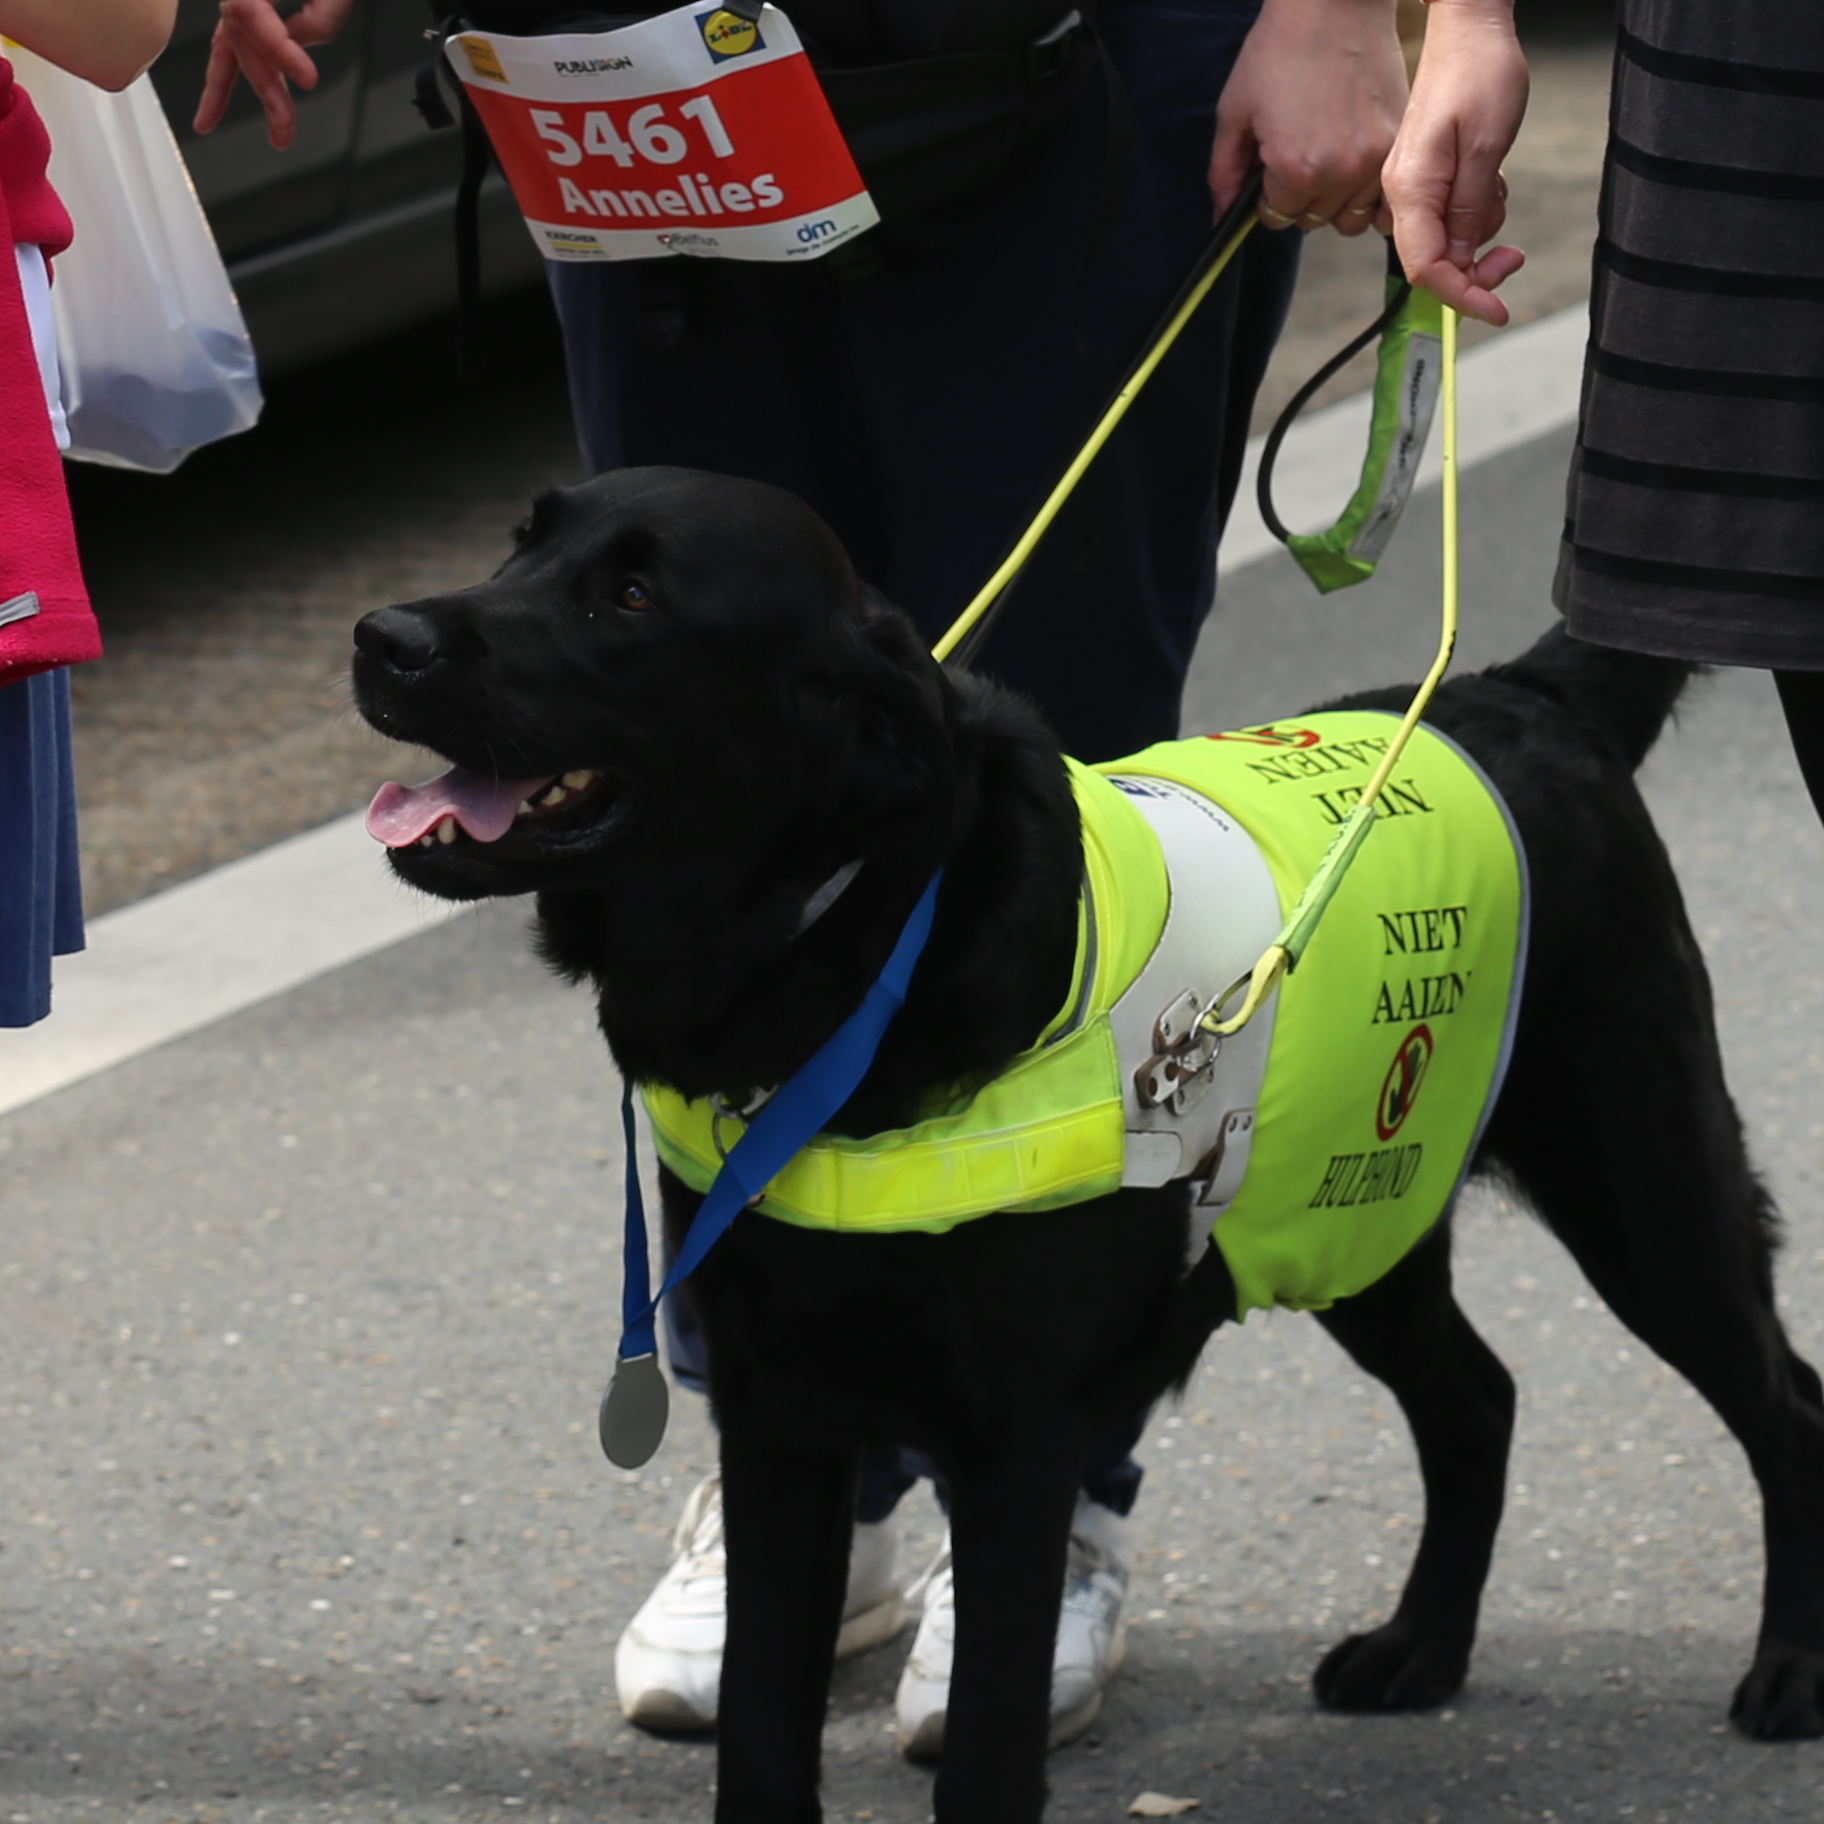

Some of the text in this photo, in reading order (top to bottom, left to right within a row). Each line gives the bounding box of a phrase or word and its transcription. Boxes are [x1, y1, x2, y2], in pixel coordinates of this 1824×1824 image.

[529, 94, 735, 168] 5461
[557, 172, 784, 218] Annelies
[797, 220, 837, 243] dm
[1377, 906, 1468, 955] NIET
[1371, 970, 1473, 1024] AAIEN
